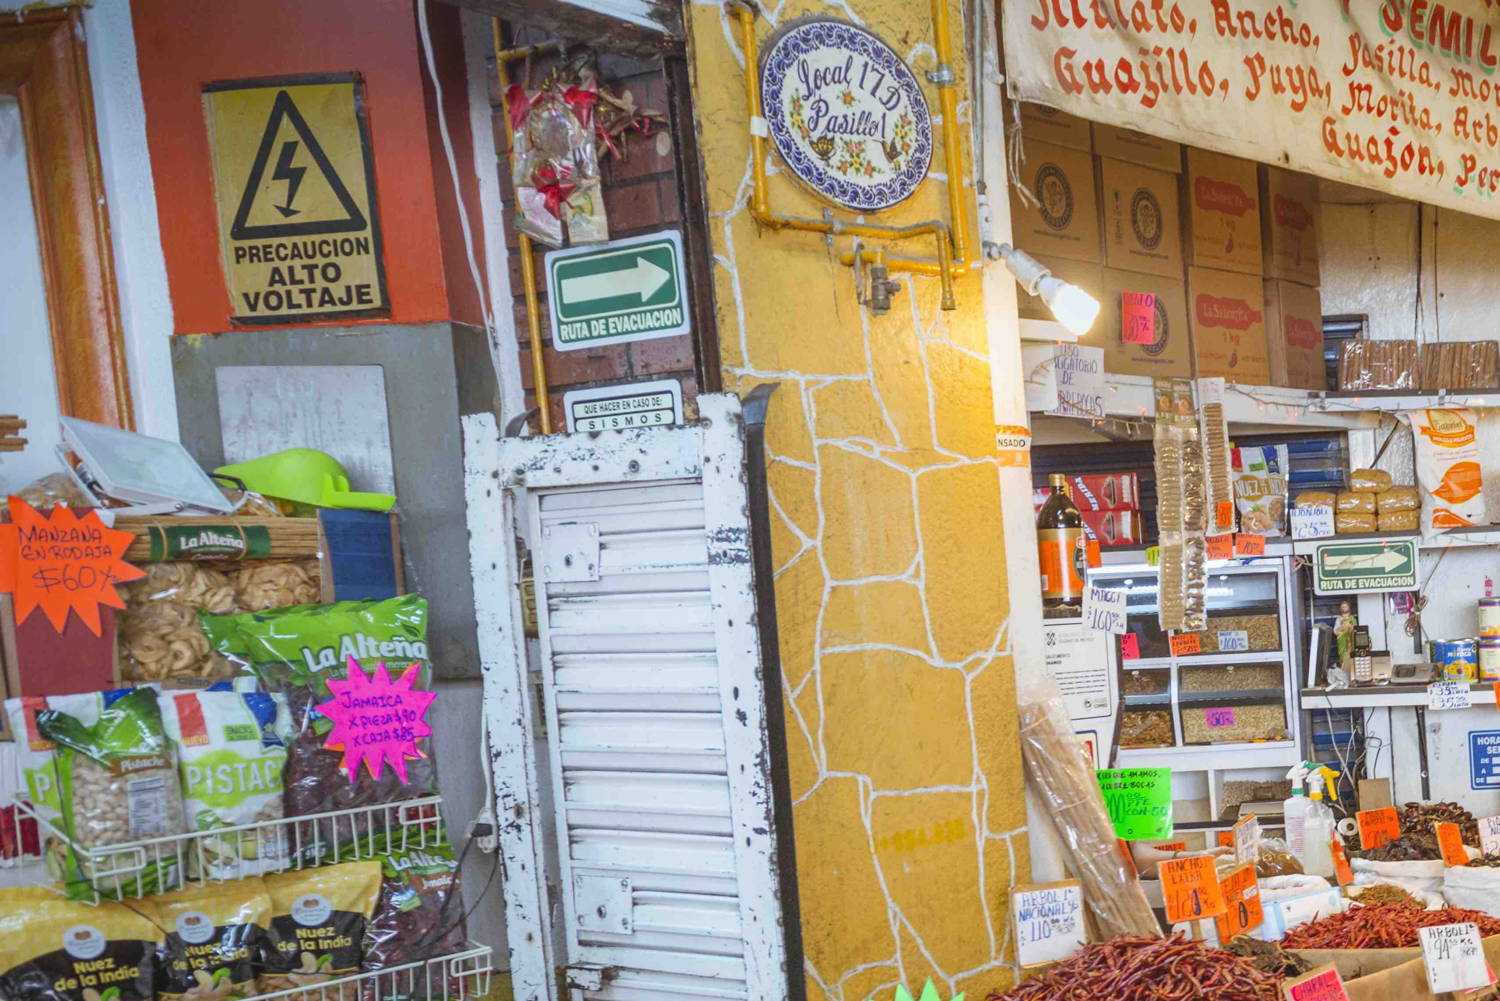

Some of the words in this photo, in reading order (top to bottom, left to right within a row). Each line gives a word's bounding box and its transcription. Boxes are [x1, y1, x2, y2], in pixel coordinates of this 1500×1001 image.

[797, 55, 854, 101] Local
[808, 98, 879, 136] Pasillo
[234, 237, 370, 264] PRECAUCION
[268, 262, 342, 287] ALTO
[242, 284, 373, 312] VOLTAJE
[560, 322, 591, 341] RUTA
[591, 318, 607, 336] DE
[608, 307, 682, 334] EVACUACION
[584, 405, 598, 415] QUE
[600, 401, 620, 413] HACER
[622, 400, 631, 410] EN
[633, 398, 650, 409] CASO
[18, 524, 104, 545] MANZANA
[180, 536, 199, 550] La
[199, 531, 244, 549] Alteña
[1320, 578, 1343, 590] RUTA
[1344, 579, 1357, 589] DE
[1358, 576, 1414, 589] EVACUACION
[302, 646, 337, 673] La
[339, 633, 428, 662] Alteña
[341, 691, 403, 708] JAMAICA
[296, 925, 335, 940] Nuez
[277, 939, 297, 953] de
[299, 937, 316, 950] la
[318, 934, 353, 949] India
[74, 958, 115, 975] Nuez
[172, 956, 188, 971] de
[54, 976, 78, 992] de
[79, 973, 97, 991] la
[100, 965, 140, 984] India
